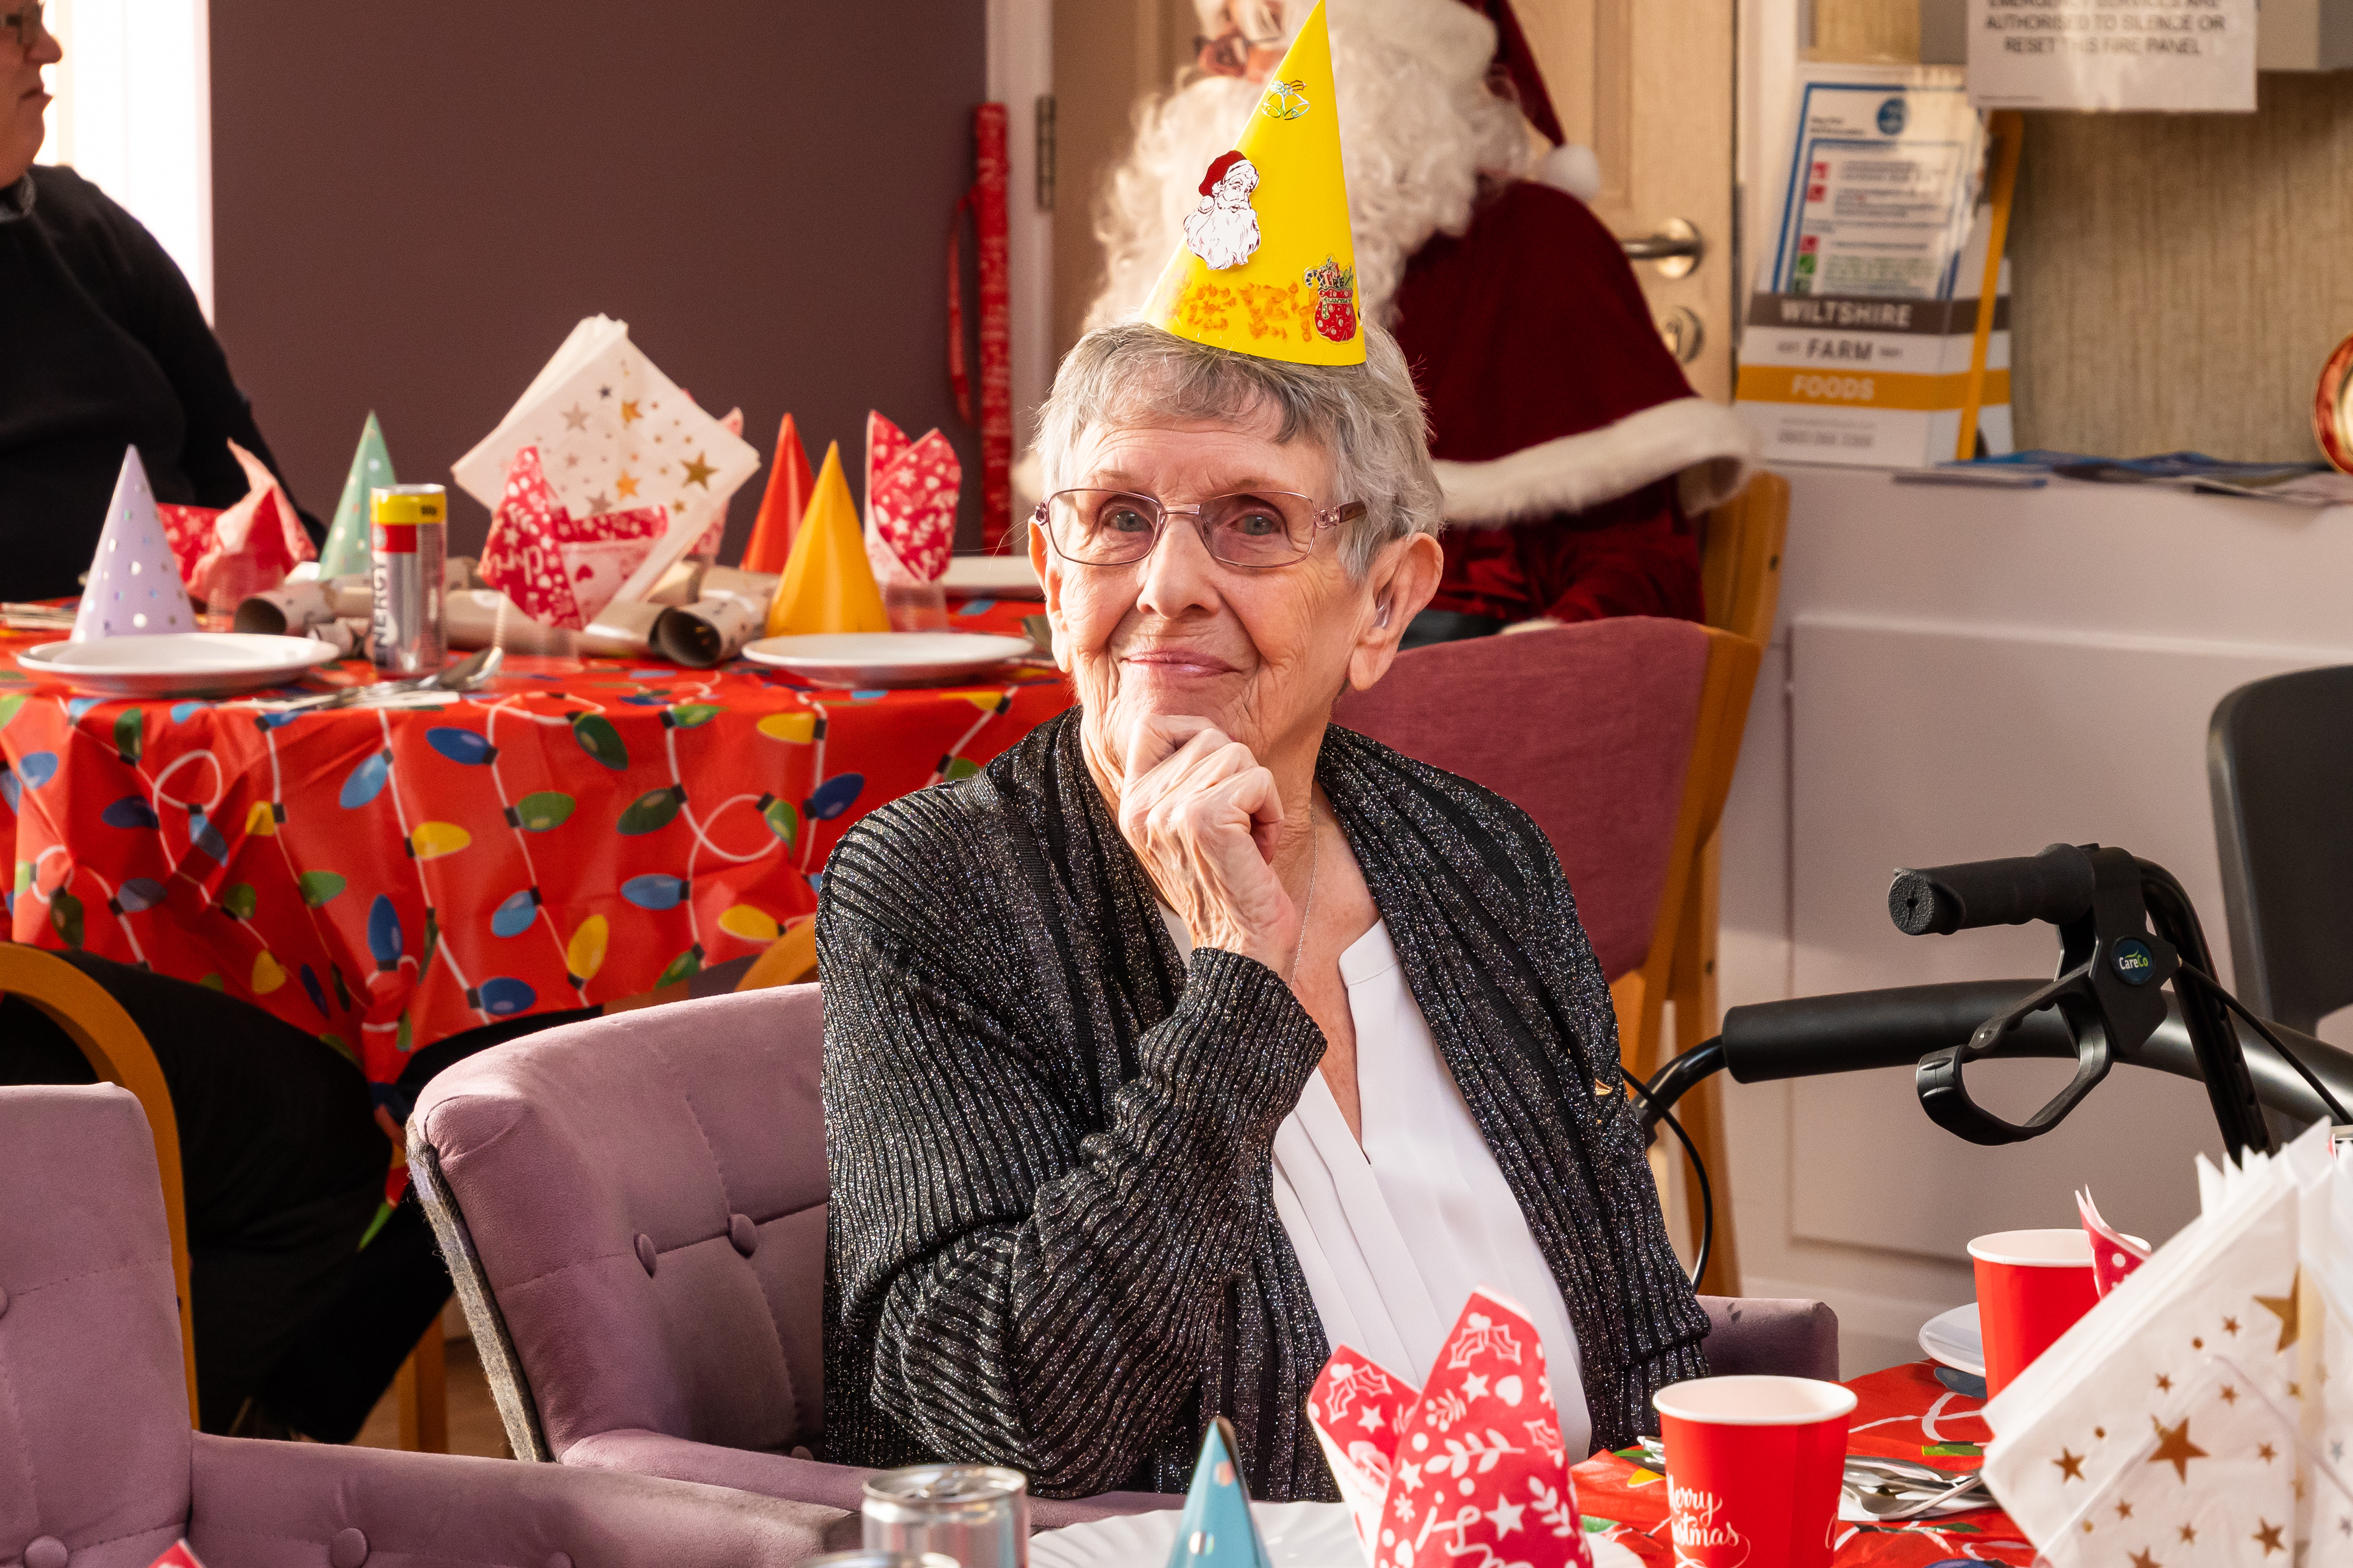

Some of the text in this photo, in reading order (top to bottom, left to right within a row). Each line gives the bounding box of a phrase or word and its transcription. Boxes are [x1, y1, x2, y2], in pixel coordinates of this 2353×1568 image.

[2094, 14, 2117, 30] TO
[2197, 14, 2226, 32] OR
[2004, 37, 2056, 53] RESET
[2146, 37, 2201, 55] PANEL
[1781, 300, 1913, 328] WILTSHIRE
[1806, 338, 1874, 361] FARM
[1792, 374, 1875, 401] FOODS
[2119, 955, 2148, 970] CareCo
